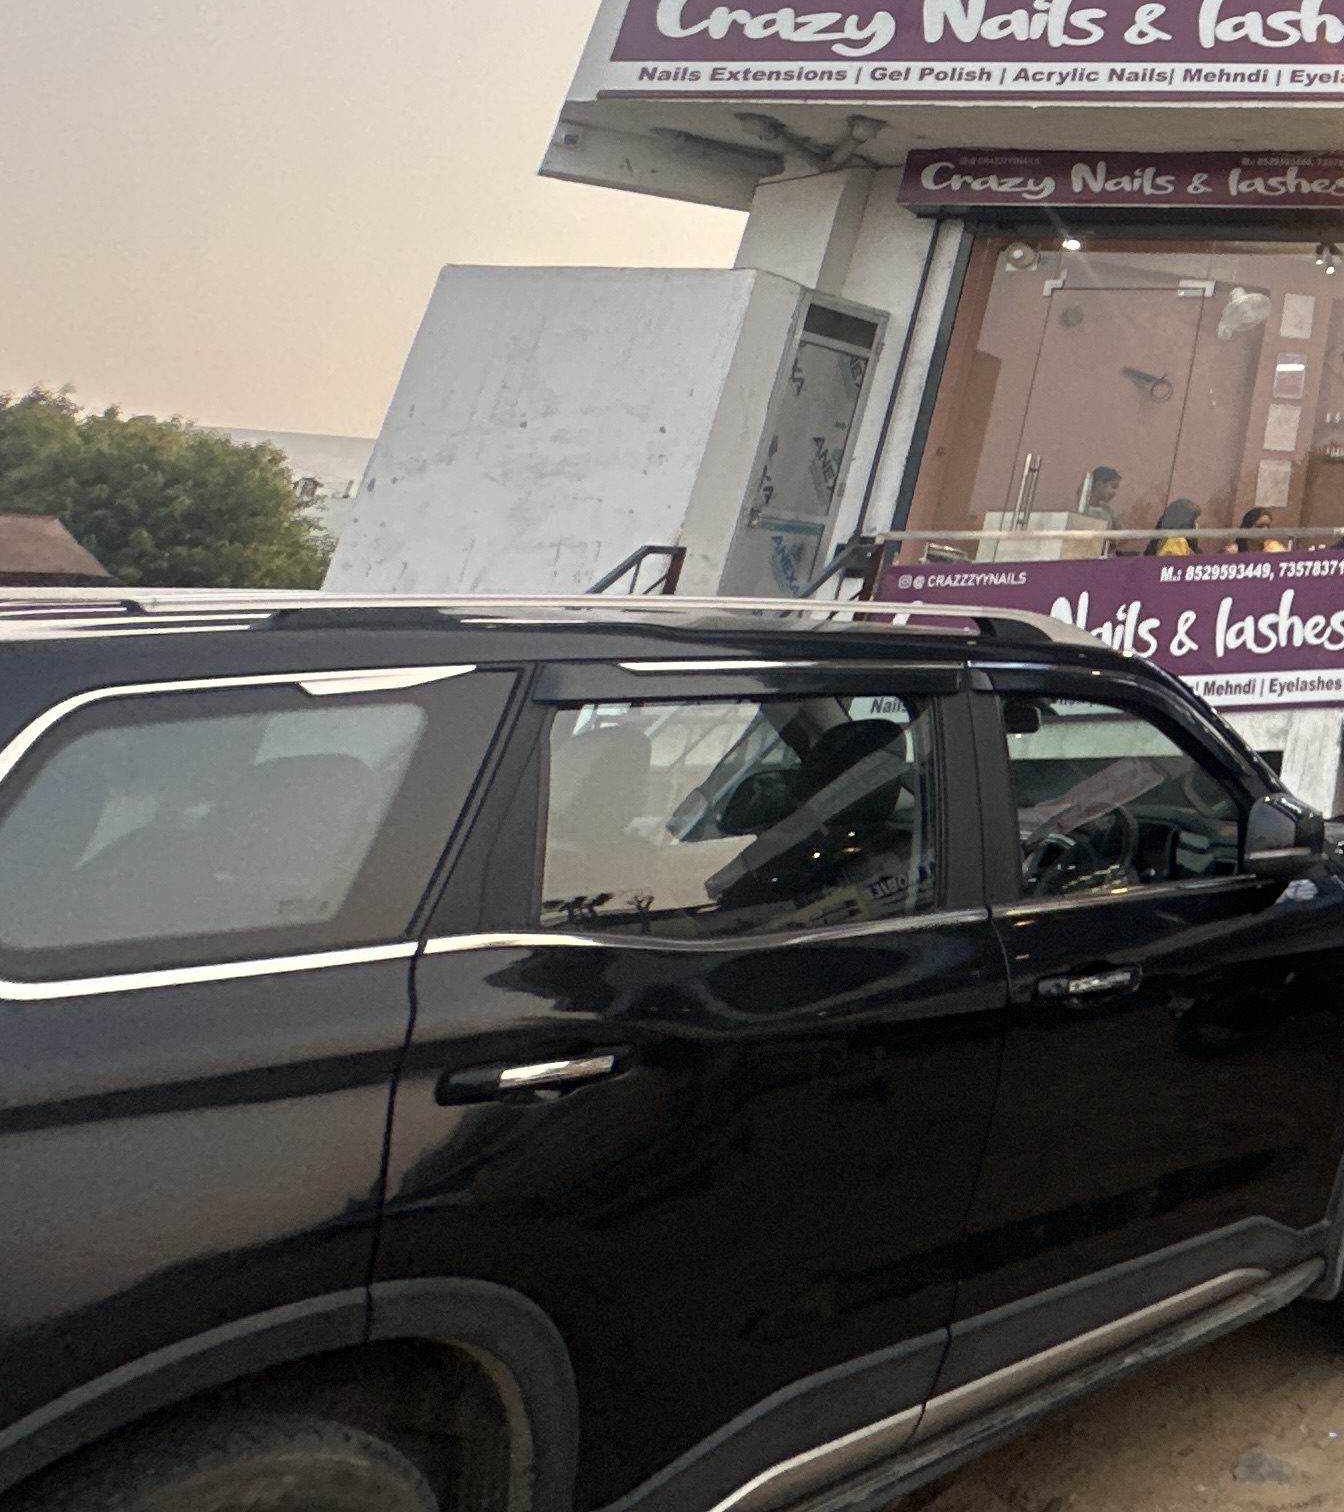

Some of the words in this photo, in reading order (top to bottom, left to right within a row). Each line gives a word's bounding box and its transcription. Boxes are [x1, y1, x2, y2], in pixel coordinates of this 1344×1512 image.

[1123, 3, 1172, 45] &
[638, 67, 701, 82] Nails
[709, 67, 847, 82] Extensions
[870, 66, 911, 82] Gel
[918, 67, 993, 82] Polish
[1013, 68, 1100, 84] Acrylic
[1182, 69, 1269, 84] Mehndi
[921, 161, 1055, 199] Crazy
[1071, 162, 1174, 195] Nails
[1186, 173, 1213, 194] &
[927, 571, 1027, 587] CRAZZZYYNAILS
[1184, 562, 1275, 582] 8529593449,
[1170, 610, 1199, 657] &
[1203, 678, 1257, 696] Mehndi
[1268, 674, 1343, 696] Eyelashes
